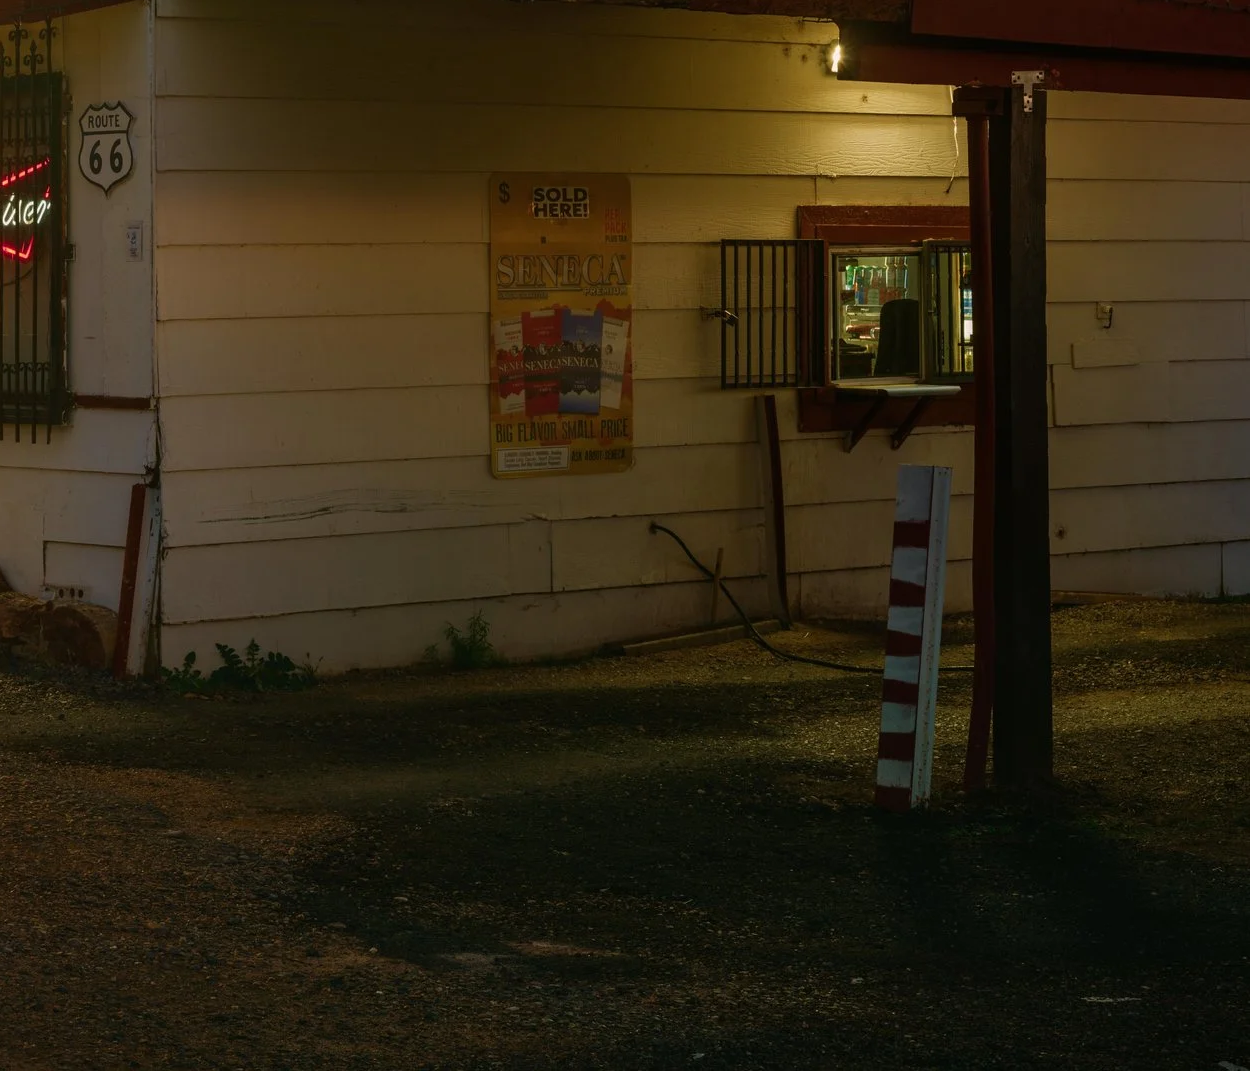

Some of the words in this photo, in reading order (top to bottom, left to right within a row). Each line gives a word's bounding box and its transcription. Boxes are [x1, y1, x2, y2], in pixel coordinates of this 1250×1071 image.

[87, 113, 120, 129] ROUTE
[89, 138, 123, 175] 66
[498, 181, 510, 204] $
[534, 188, 587, 202] SOLD
[534, 203, 587, 218] HERE!
[582, 287, 627, 297] PREMIUM
[562, 356, 599, 369] SENECA
[517, 421, 557, 442] FLAVOR
[561, 419, 597, 441] SMALL
[600, 417, 629, 440] PRICE
